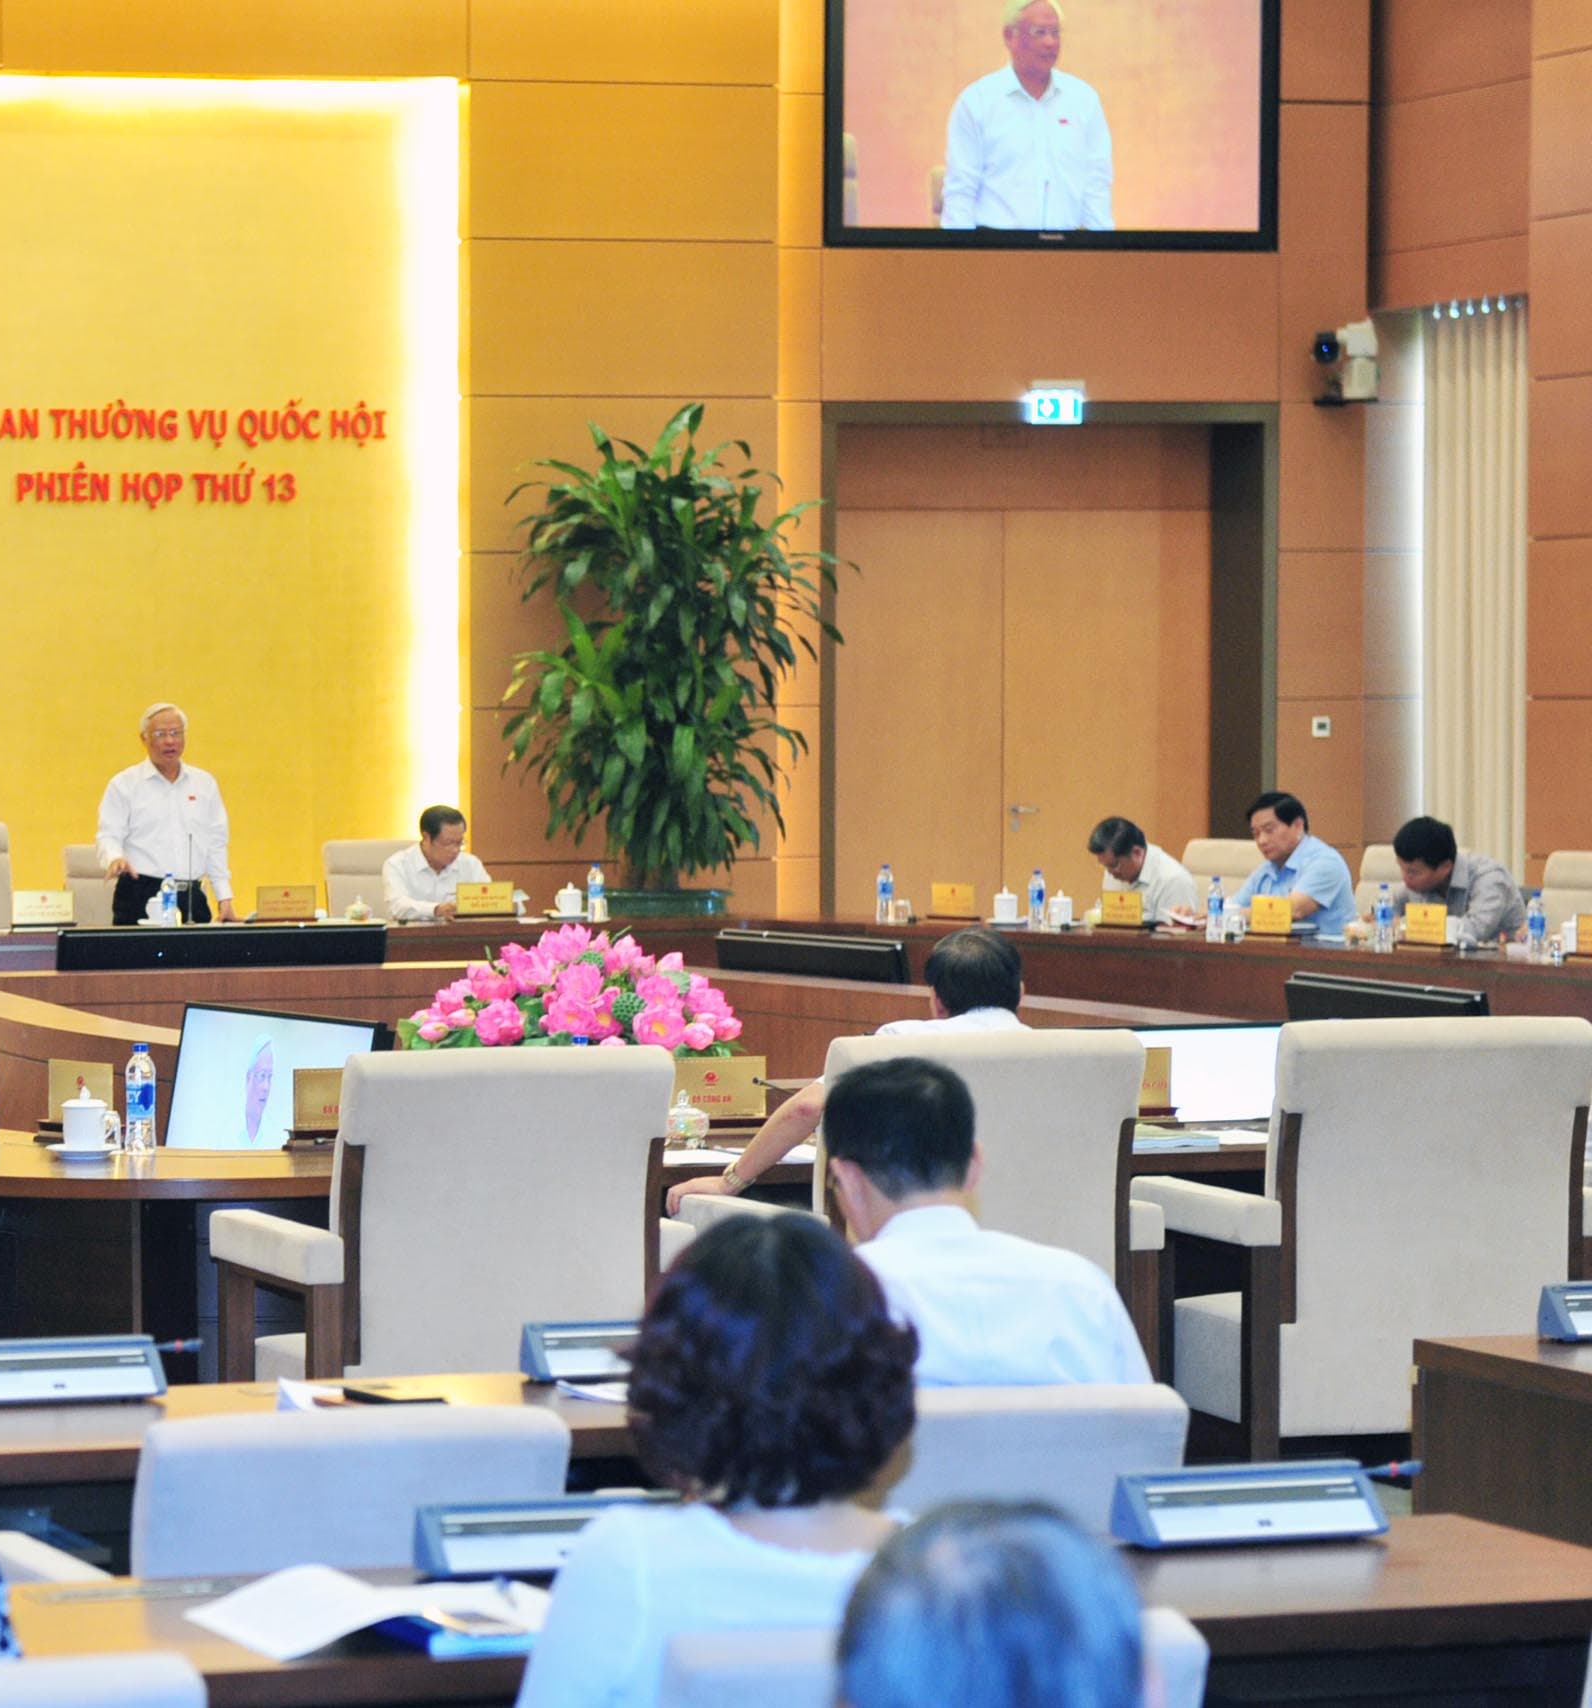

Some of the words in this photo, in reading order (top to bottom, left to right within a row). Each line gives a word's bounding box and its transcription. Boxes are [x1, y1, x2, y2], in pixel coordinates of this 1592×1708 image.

[50, 400, 179, 442] THƯỜNG
[188, 410, 228, 449] VỤ
[237, 400, 321, 449] QUỐC
[330, 402, 387, 448] HỘI
[16, 461, 111, 505] PHIÊN
[121, 472, 184, 511] HỌP
[192, 463, 257, 506] THỨ
[262, 474, 298, 504] 13
